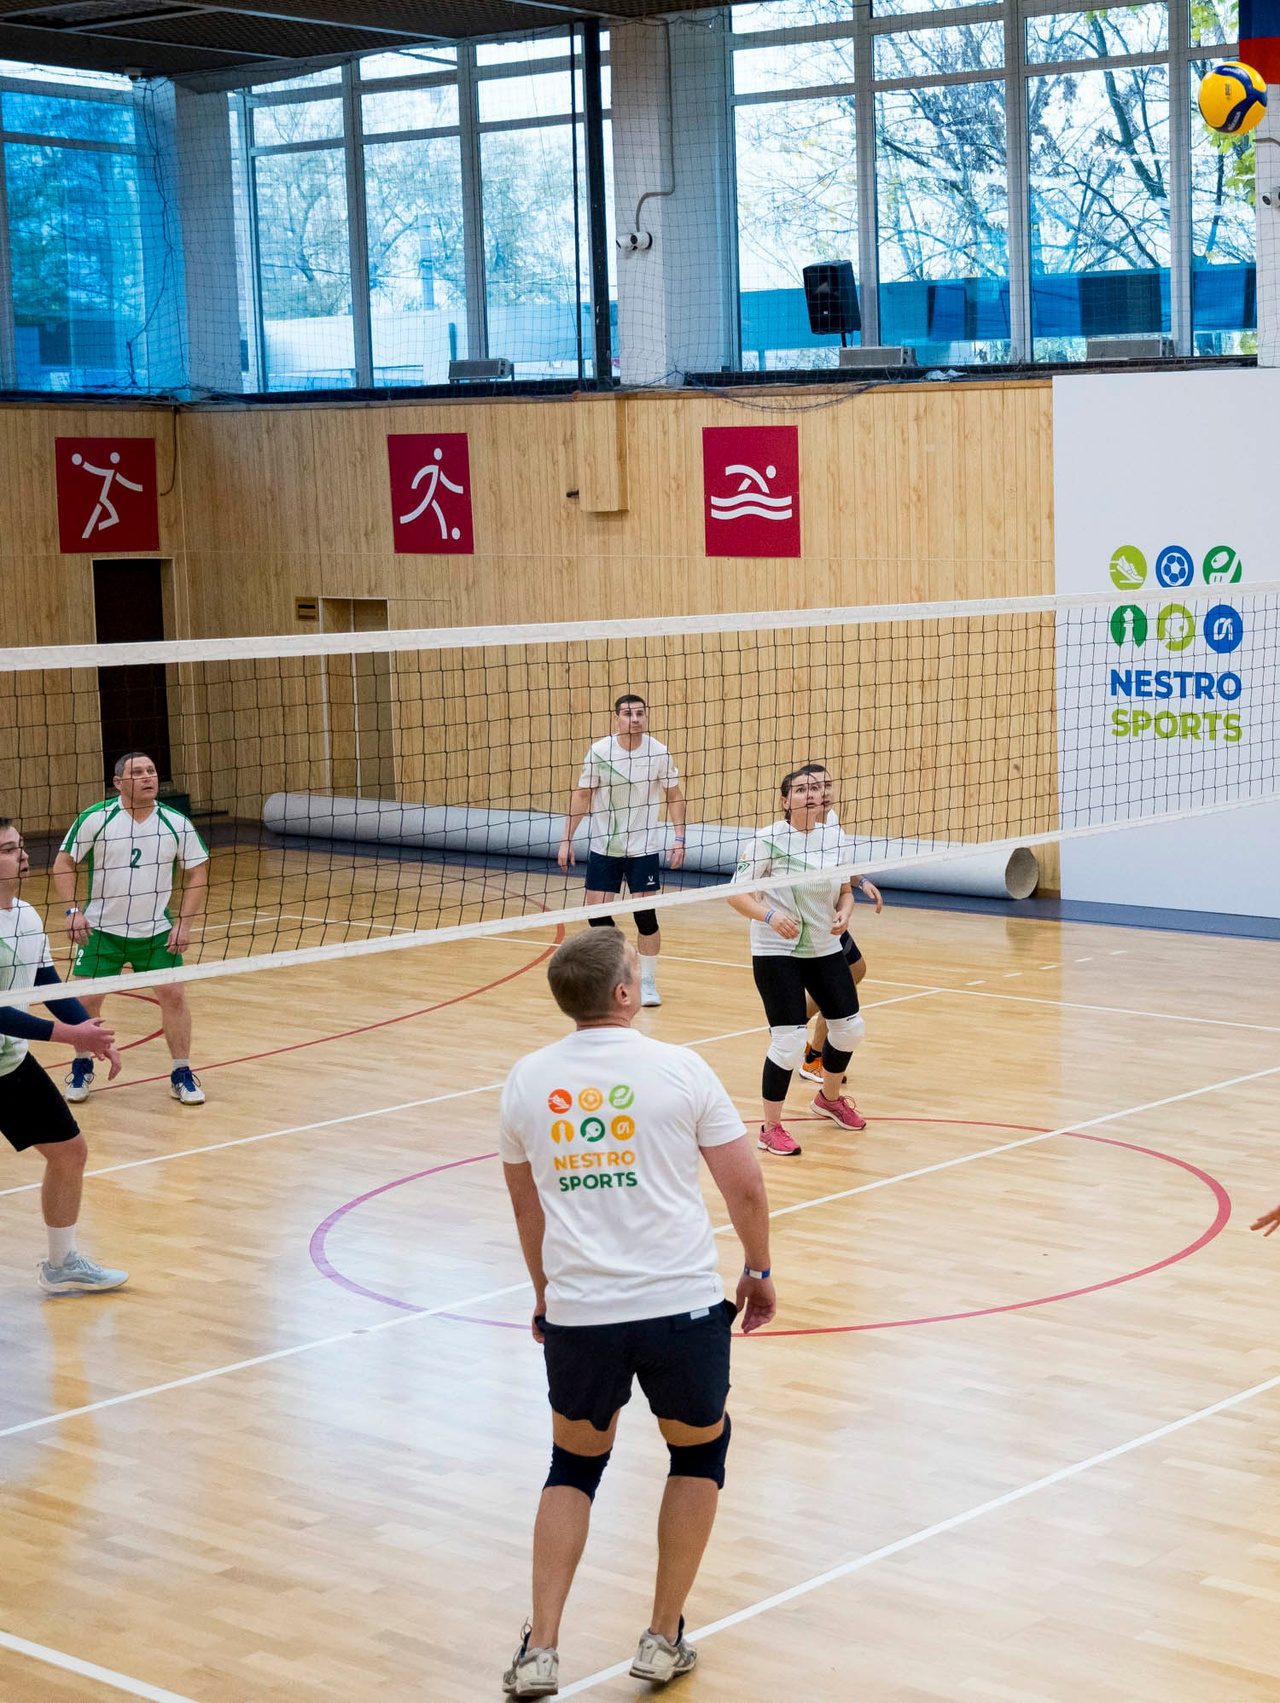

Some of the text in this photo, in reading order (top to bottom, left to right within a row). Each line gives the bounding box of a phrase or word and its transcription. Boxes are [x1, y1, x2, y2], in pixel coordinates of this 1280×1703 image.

[1110, 668, 1242, 701] NESTRO
[1111, 708, 1243, 743] SPORTS
[129, 847, 142, 869] 2
[553, 1149, 636, 1171] NESTRO
[559, 1171, 638, 1192] SPORTS
